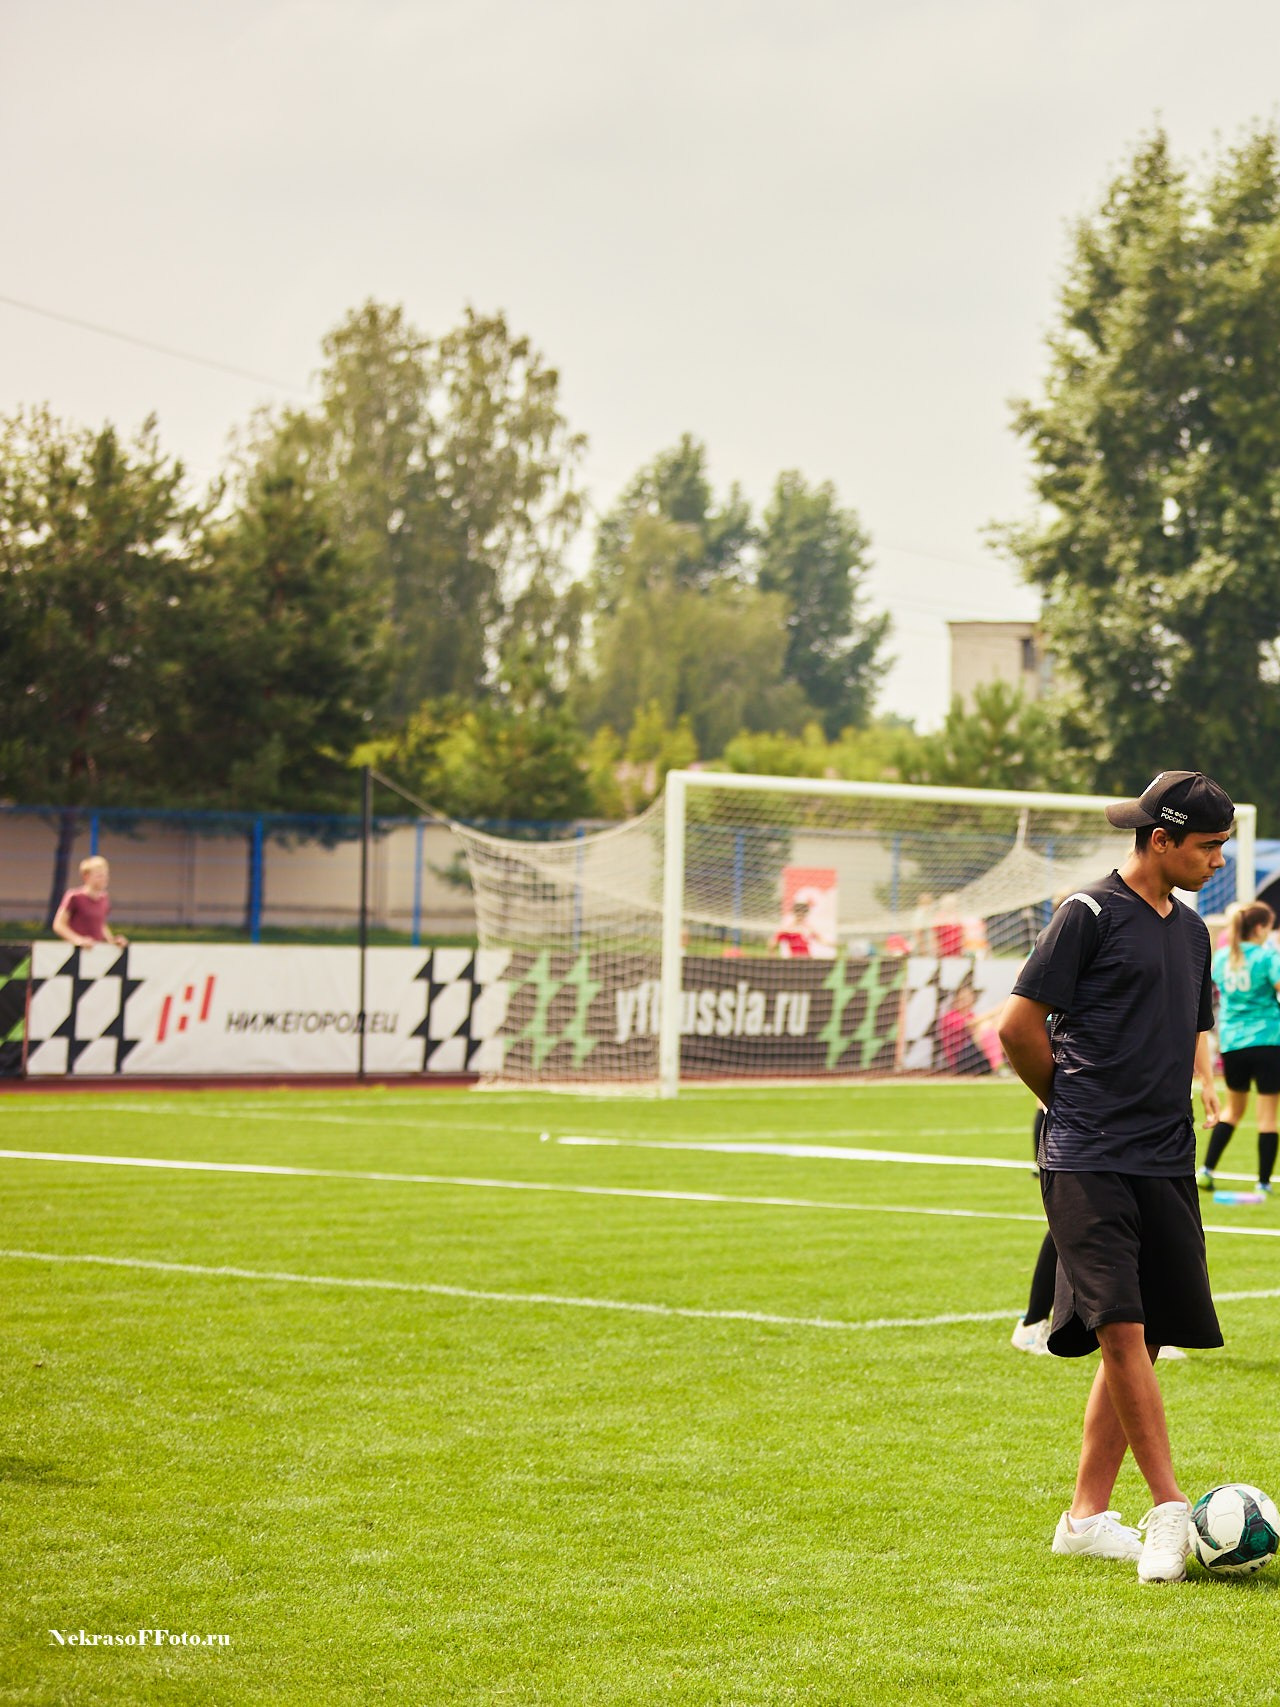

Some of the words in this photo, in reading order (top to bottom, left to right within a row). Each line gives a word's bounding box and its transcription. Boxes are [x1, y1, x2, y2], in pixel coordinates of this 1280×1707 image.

[1160, 812, 1185, 825] РОССИИ
[1161, 806, 1174, 815] СПБ
[615, 980, 811, 1044] yflussia.ru
[225, 1010, 399, 1035] НИЖЕГОРОДЕЦ
